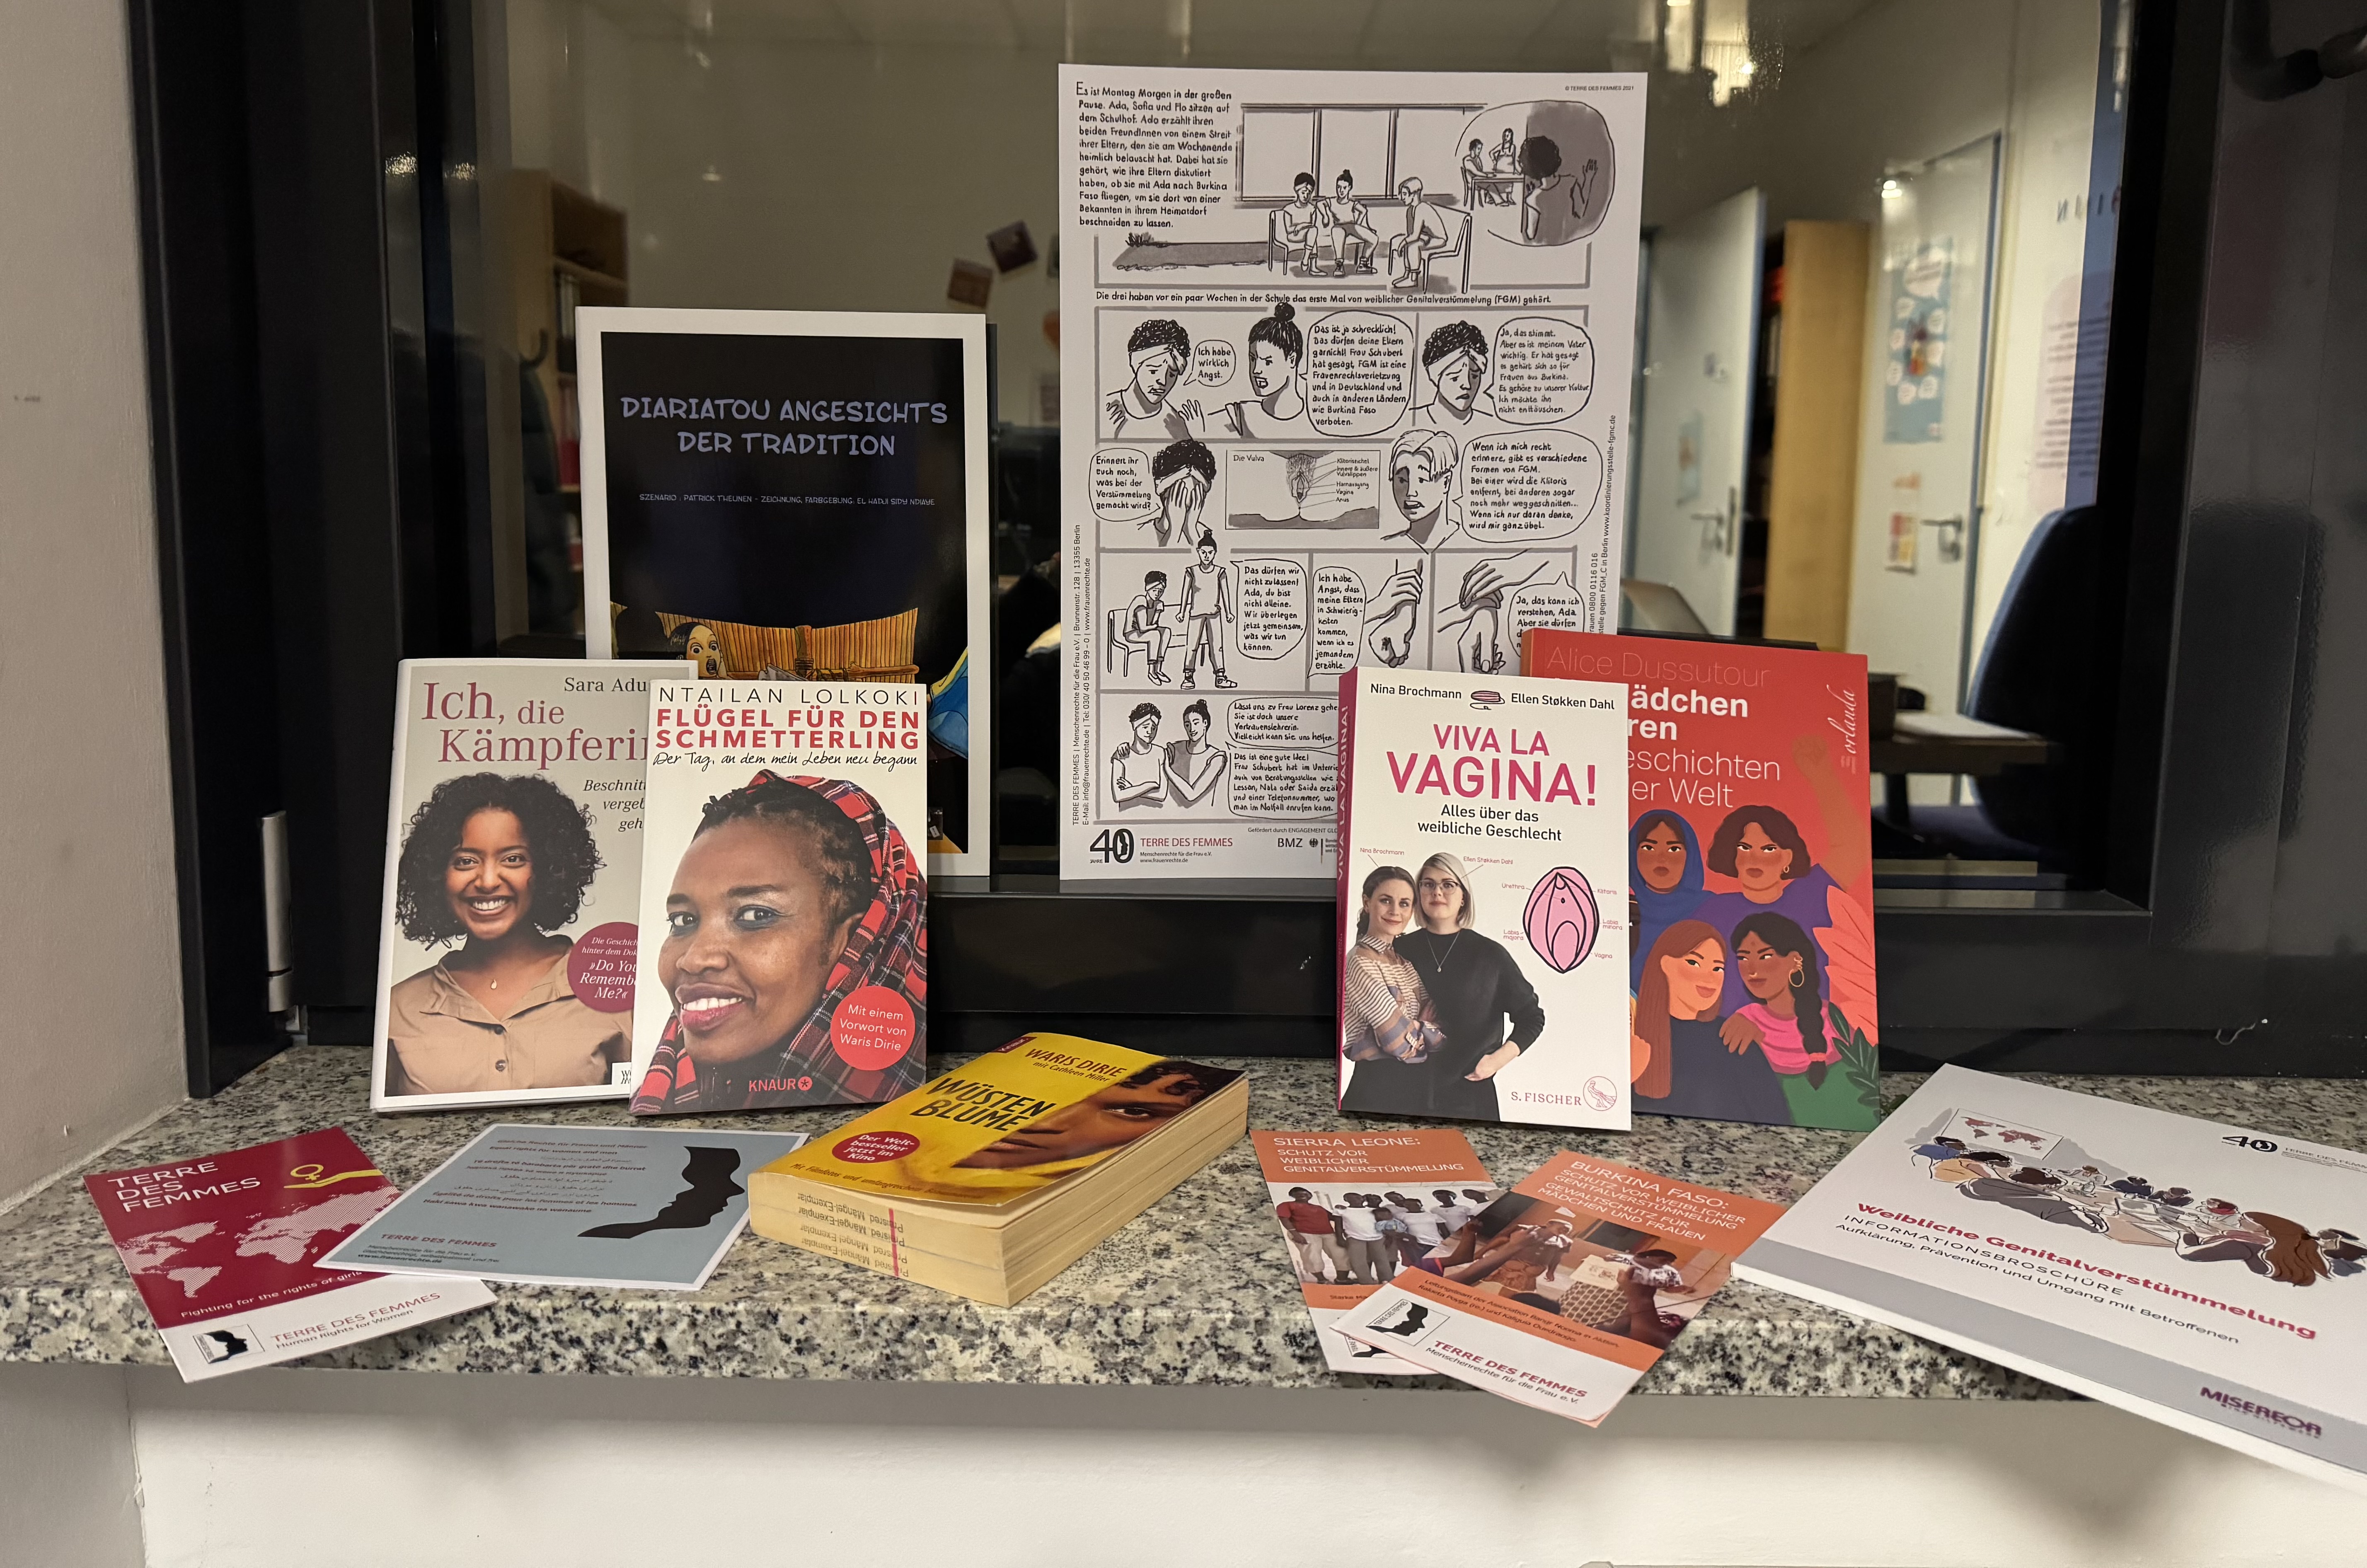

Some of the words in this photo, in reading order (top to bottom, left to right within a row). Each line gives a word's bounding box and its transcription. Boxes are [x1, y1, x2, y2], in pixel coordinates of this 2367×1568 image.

[1077, 82, 1088, 96] Es
[1091, 87, 1099, 96] ist
[1102, 87, 1135, 99] Montag
[1138, 89, 1171, 100] Morgen
[1174, 90, 1181, 99] in
[1185, 90, 1198, 99] der
[1201, 90, 1232, 102] großen
[1129, 293, 1153, 301] haben
[1206, 293, 1237, 302] Wochen
[1250, 294, 1262, 302] der
[1266, 294, 1290, 302] Schule
[1365, 295, 1404, 303] weiblicher
[1406, 295, 1492, 306] Genitalverstümmelung
[1494, 295, 1521, 305] (FGM)
[1523, 295, 1551, 306] gehört.
[1198, 347, 1210, 356] Ich
[1213, 347, 1231, 356] habe
[1198, 371, 1222, 380] Angst.
[621, 397, 770, 421] DIARIATOU
[780, 401, 948, 423] ANGESICHTS
[678, 431, 731, 453] DER
[742, 433, 895, 456] TRADITION
[1547, 646, 1612, 676] Alice
[1623, 652, 1771, 687] Dussutour
[564, 678, 604, 692] Sara
[660, 687, 782, 703] NTAILAN
[801, 689, 917, 705] LOLKOKI
[1370, 683, 1395, 695] Nina
[1399, 685, 1462, 699] Brochmann
[1511, 692, 1539, 704] Ellen
[1542, 695, 1586, 708] Støkken
[1590, 698, 1615, 710] Dahl
[421, 682, 504, 725] Ich,
[518, 700, 564, 724] die
[1631, 685, 1748, 717] ädchen
[657, 704, 774, 727] FLÜGEL
[788, 705, 844, 728] FÜR
[859, 711, 918, 729] DEN
[1827, 685, 1857, 754] orlanda
[656, 730, 918, 749] SCHMETTERLING
[1433, 724, 1501, 753] VIVA
[1511, 728, 1550, 756] LA
[653, 752, 681, 765] Der
[685, 753, 715, 772] Tag,
[721, 755, 736, 764] an
[741, 753, 766, 765] dem
[771, 754, 798, 764] mein
[802, 751, 841, 765] Leben
[845, 755, 869, 765] neu
[873, 751, 917, 771] begann
[1628, 748, 1780, 781] eschichten
[1387, 751, 1595, 806] VAGINA!
[1669, 777, 1733, 808] Welt
[1441, 804, 1475, 818] Alles
[1479, 807, 1511, 821] über
[1515, 809, 1539, 822] das
[1140, 838, 1169, 847] TERRE
[1172, 838, 1190, 847] DES
[1193, 838, 1232, 847] FEMMES
[1278, 838, 1302, 848] BMZ
[1418, 821, 1482, 836] weibliche
[1486, 825, 1562, 842] Geschlecht
[1090, 828, 1134, 863] 40
[594, 987, 627, 999] Me?«
[848, 1004, 866, 1016] Mit
[869, 1008, 903, 1021] einem
[840, 1018, 883, 1033] Vorwort
[886, 1026, 907, 1036] von
[840, 1033, 871, 1047] Waris
[874, 1038, 901, 1050] Dirie
[1025, 1048, 1080, 1068] WARIS
[1078, 1059, 1127, 1077] DIRIE
[1049, 1064, 1085, 1077] Cathleen
[1086, 1073, 1111, 1083] Miller
[749, 1079, 796, 1092] KNAUR
[927, 1077, 1057, 1117] WÜSTEN
[1511, 1092, 1522, 1101] S.
[1525, 1093, 1581, 1106] FISCHER
[910, 1099, 1030, 1131] BLUME
[844, 1146, 873, 1154] jetzt
[850, 1140, 908, 1152] bestseller
[885, 1137, 915, 1146] Welt-
[1273, 1137, 1346, 1146] SIERRA
[1351, 1137, 1421, 1146] LEONE:
[2222, 1136, 2277, 1152] 40
[108, 1162, 218, 1188] TERRE
[1283, 1164, 1463, 1173] GENITALVERSTÜMMELUNG
[116, 1181, 183, 1200] DES
[123, 1177, 260, 1212] FEMMES
[1561, 1169, 1617, 1190] SCHUTZ
[1622, 1186, 1650, 1200] VOR
[1655, 1195, 1746, 1224] WEIBLICHER
[1571, 1161, 1660, 1192] BURKINA
[1668, 1188, 1729, 1209] FASO:
[1538, 1188, 1607, 1213] MÄDCHEN
[1611, 1210, 1643, 1224] UND
[1646, 1221, 1706, 1241] FRAUEN
[1546, 1182, 1658, 1219] GEWALTSCHUTZ
[1661, 1216, 1689, 1228] FÜR
[1555, 1175, 1738, 1229] GENITALVERSTÜMMELUNG
[448, 1239, 497, 1247] FEMMES
[1845, 1215, 2123, 1298] INFORMATIONSBROSCHÜRE
[1836, 1224, 1915, 1249] Aufklärung,
[1920, 1245, 1998, 1271] Prävention
[2003, 1268, 2032, 1280] und
[2037, 1278, 2104, 1303] Umgang
[2109, 1299, 2135, 1312] mit
[2140, 1309, 2239, 1343] Betroffenen
[1858, 1203, 1979, 1239] Weibliche
[1986, 1236, 2316, 1340] Genitalverstümmelung
[181, 1303, 232, 1318] Fighting
[237, 1297, 254, 1306] for
[259, 1291, 278, 1300] the
[283, 1282, 317, 1295] rights
[337, 1271, 362, 1281] girls
[271, 1324, 327, 1342] TERRE
[332, 1314, 365, 1327] DES
[369, 1293, 440, 1317] FEMMES
[1435, 1340, 1483, 1363] TERRE
[1486, 1360, 1517, 1374] DES
[1520, 1372, 1588, 1397] FEMMES
[2200, 1387, 2321, 1435] MISEREOR
